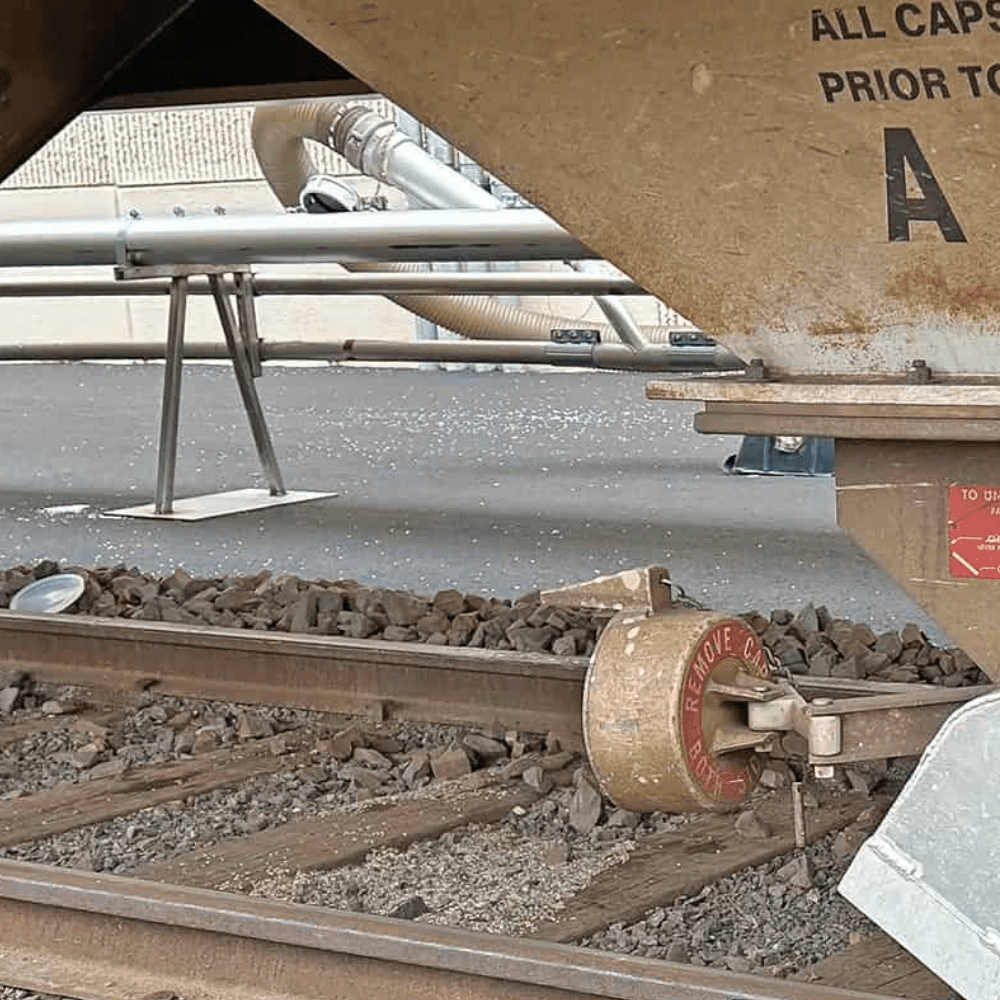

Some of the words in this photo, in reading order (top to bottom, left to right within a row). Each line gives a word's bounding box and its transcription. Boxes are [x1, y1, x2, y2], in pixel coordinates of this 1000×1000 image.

[811, 6, 886, 41] ALL
[818, 67, 950, 102] PRIOR
[883, 127, 968, 243] A
[961, 488, 978, 501] TO
[685, 626, 733, 712] REMOVE
